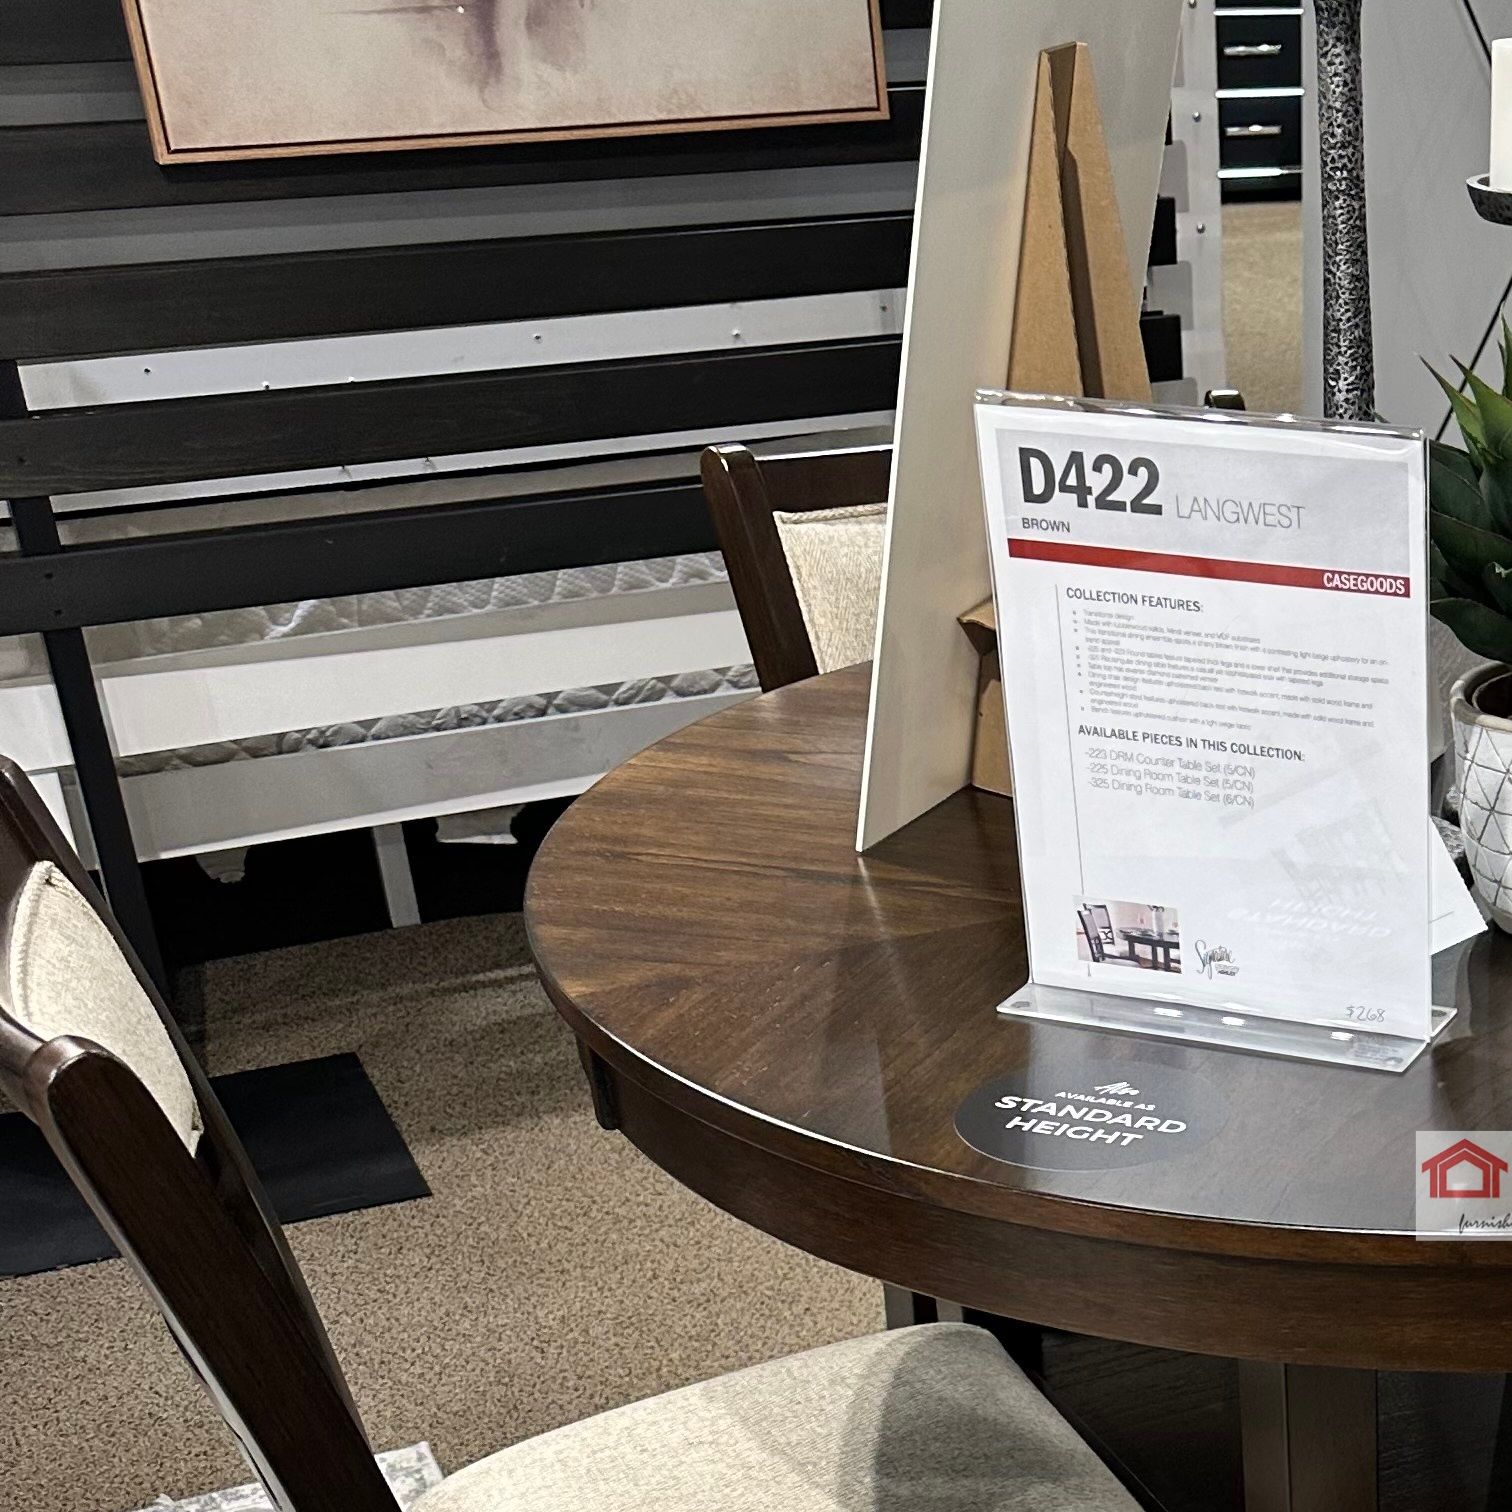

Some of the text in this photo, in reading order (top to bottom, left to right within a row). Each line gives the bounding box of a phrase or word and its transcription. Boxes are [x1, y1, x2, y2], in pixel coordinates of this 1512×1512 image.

[1018, 446, 1306, 530] D422 LANGWEST
[1021, 517, 1071, 534] BROWN
[1323, 572, 1405, 595] CASEGOODS
[1066, 587, 1204, 613] COLLECTION FEATURES:
[1078, 724, 1305, 762] AVAILABLE PIECES IN THIS COLLECTION:
[1109, 749, 1134, 763] DRM
[1178, 757, 1202, 771] Table
[1205, 760, 1221, 773] Set
[1111, 764, 1141, 780] Dining
[1144, 768, 1173, 782] Room
[1176, 771, 1201, 786] Table
[1203, 775, 1219, 789] Set
[1112, 779, 1142, 796] Dining
[1145, 783, 1174, 797] Room
[1178, 787, 1202, 801] Table
[1204, 791, 1220, 803] Set
[1346, 1005, 1386, 1023] $268
[1055, 1091, 1156, 1111] AVAILABLE AS
[995, 1095, 1187, 1133] STANDARD
[1005, 1116, 1144, 1147] HEIGHT
